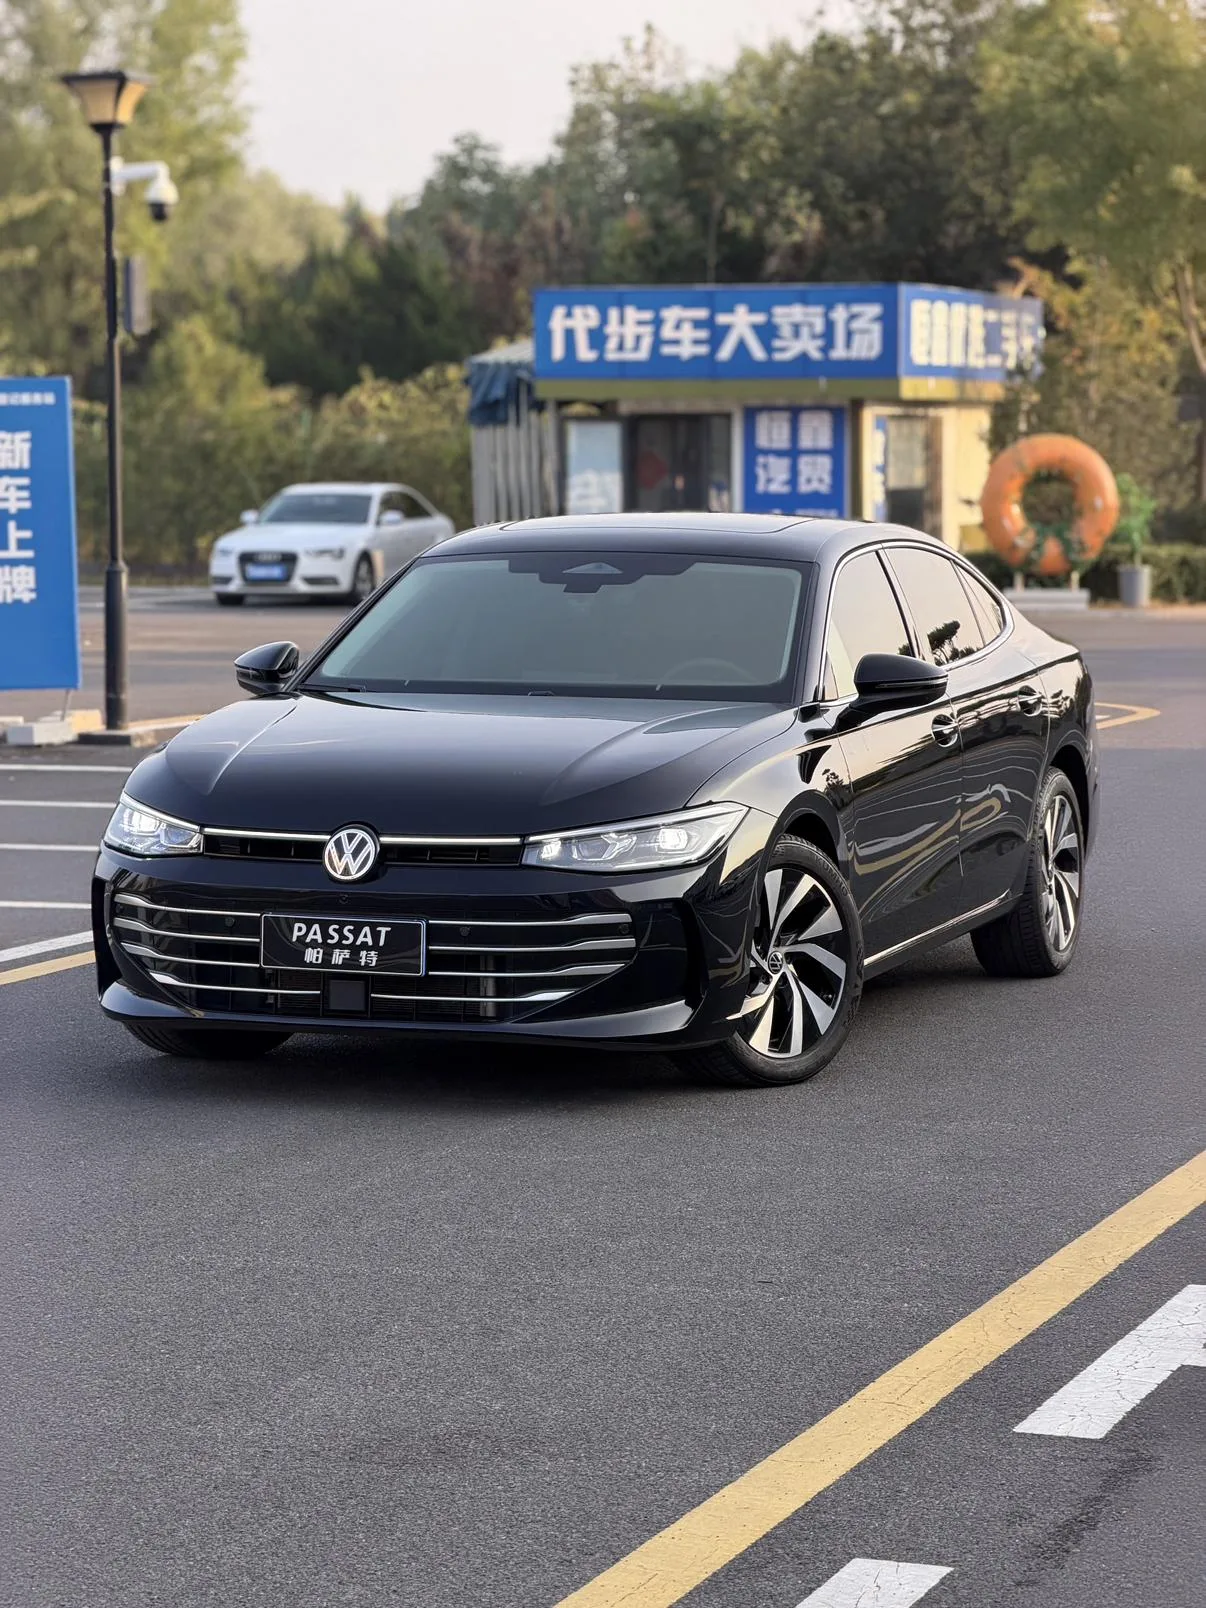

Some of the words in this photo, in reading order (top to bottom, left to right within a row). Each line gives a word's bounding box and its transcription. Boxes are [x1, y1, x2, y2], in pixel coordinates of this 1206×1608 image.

[549, 303, 884, 362] 代步车大卖场
[291, 922, 392, 947] PASSAT
[304, 947, 379, 967] 帕萨特
